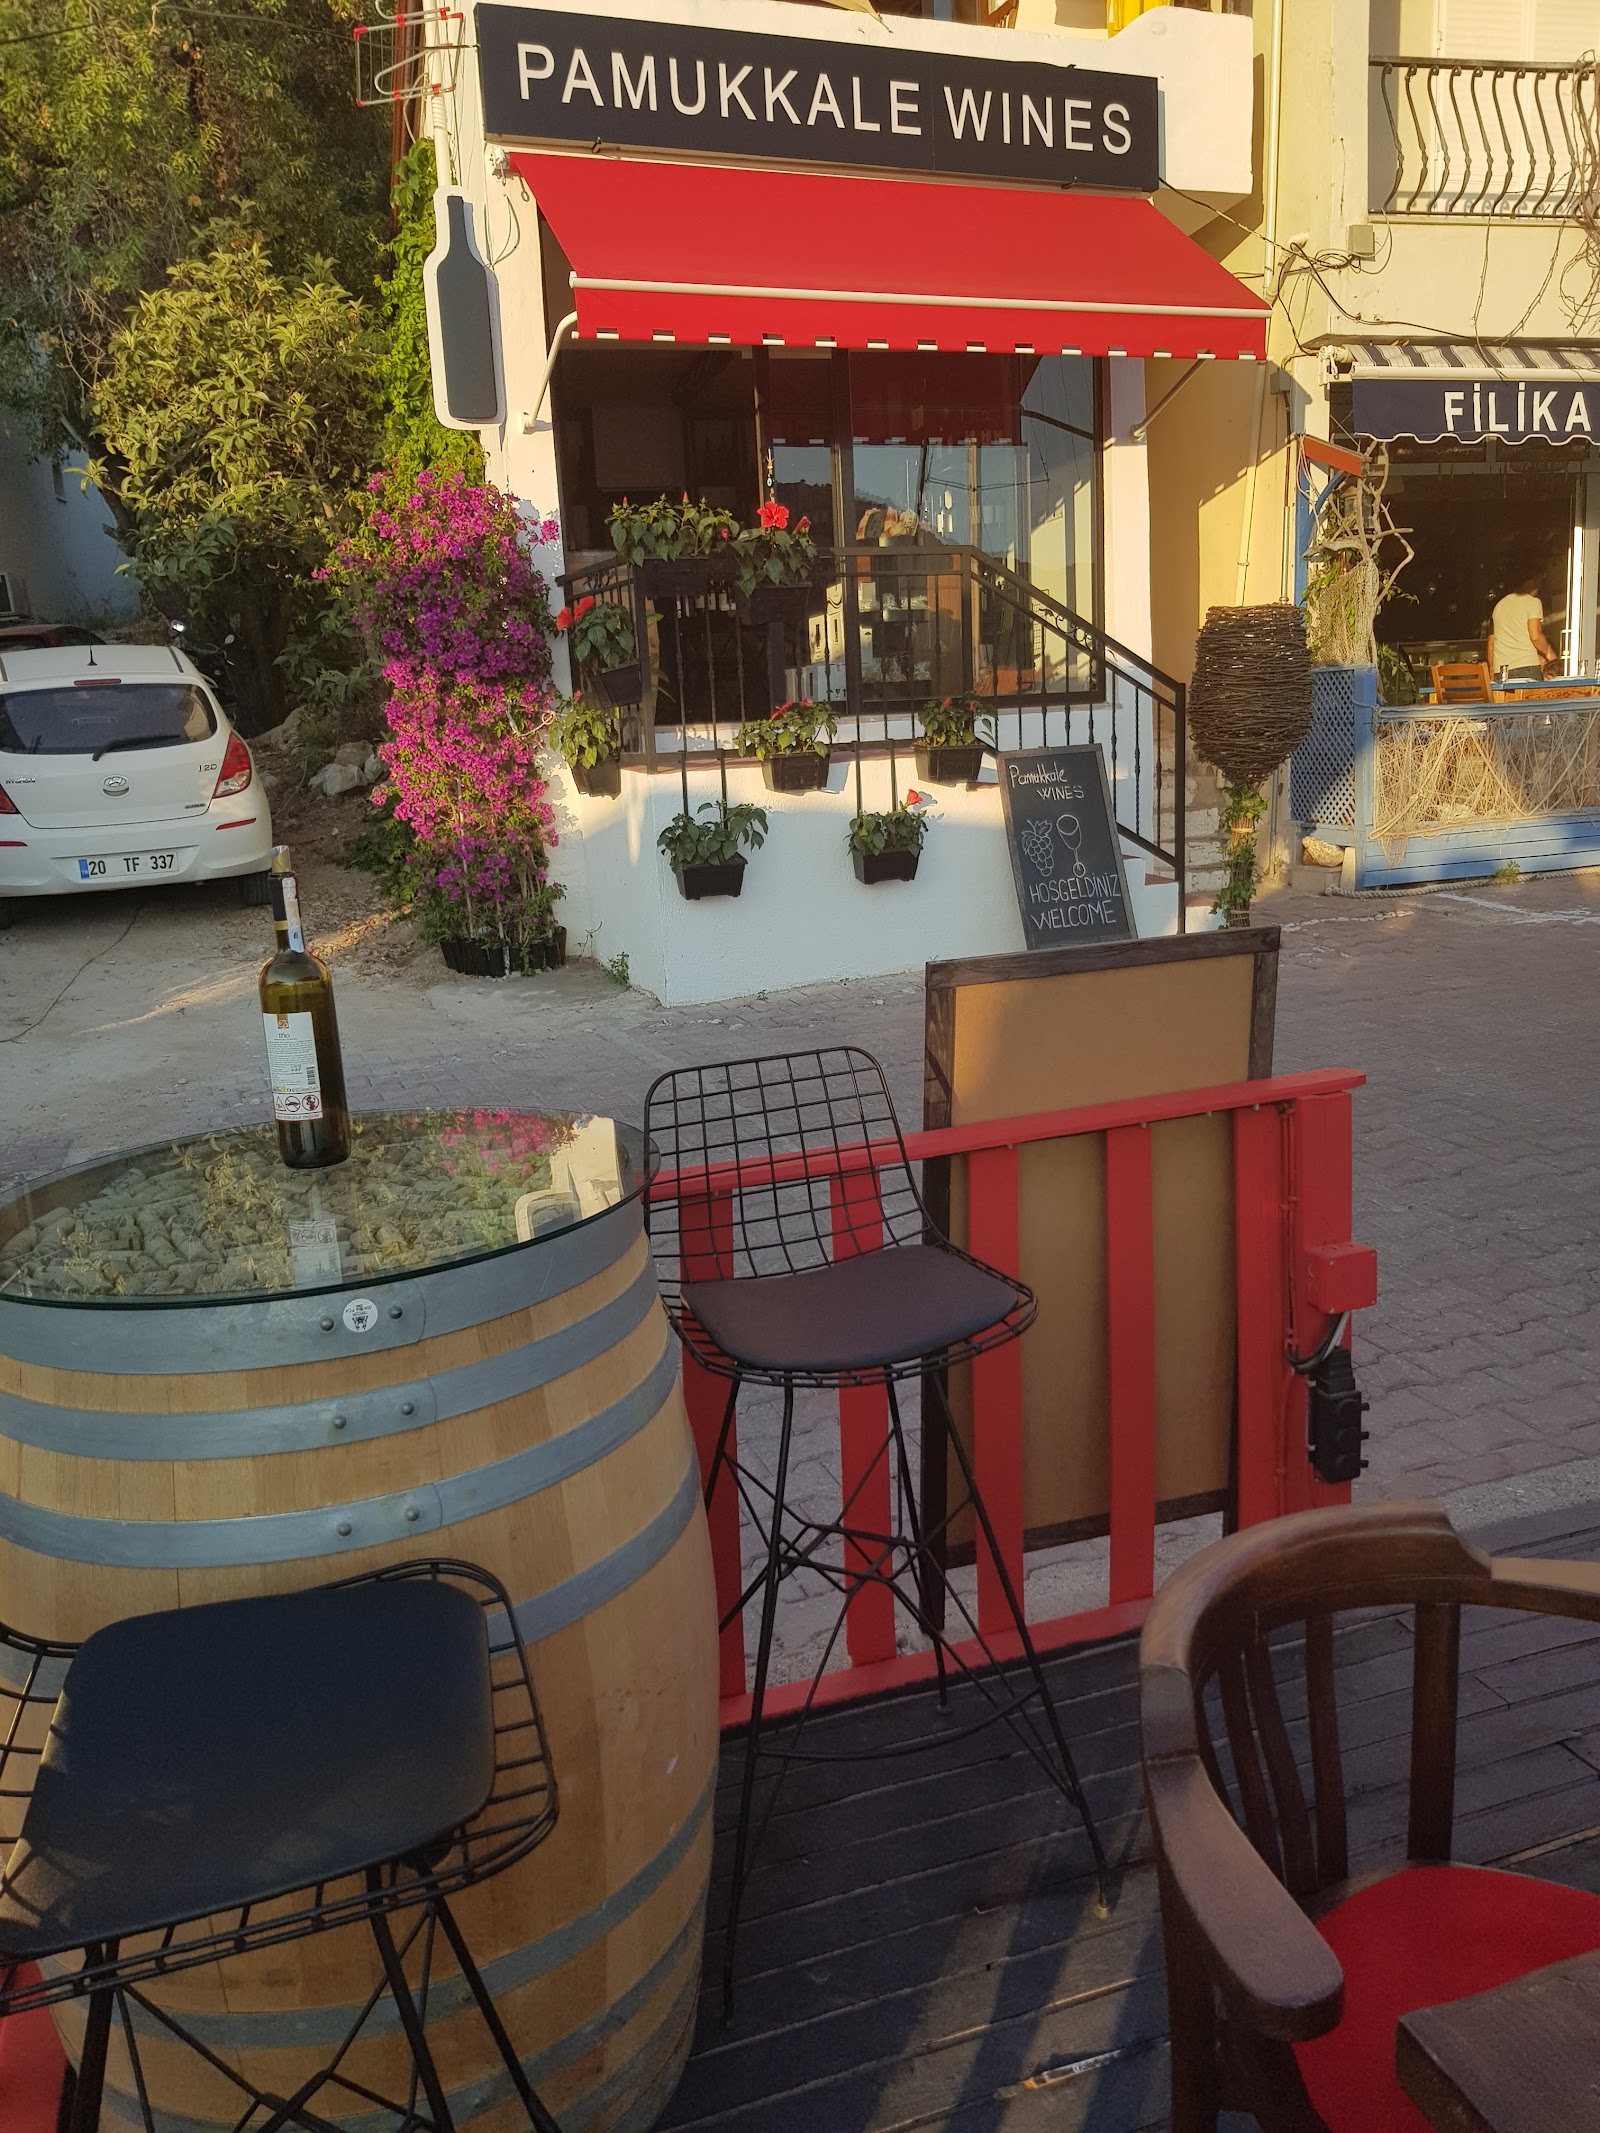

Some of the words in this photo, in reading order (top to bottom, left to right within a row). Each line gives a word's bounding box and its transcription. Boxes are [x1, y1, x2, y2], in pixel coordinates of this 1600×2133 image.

[517, 42, 922, 136] PAMUKKALE
[942, 86, 1132, 155] WINES
[1444, 382, 1591, 432] FİLİKA
[1008, 762, 1068, 788] Pamukkale
[1037, 785, 1084, 800] WINES
[89, 860, 106, 875] 20
[123, 857, 140, 872] TF
[150, 854, 174, 870] 337
[1031, 900, 1116, 930] WELCOME
